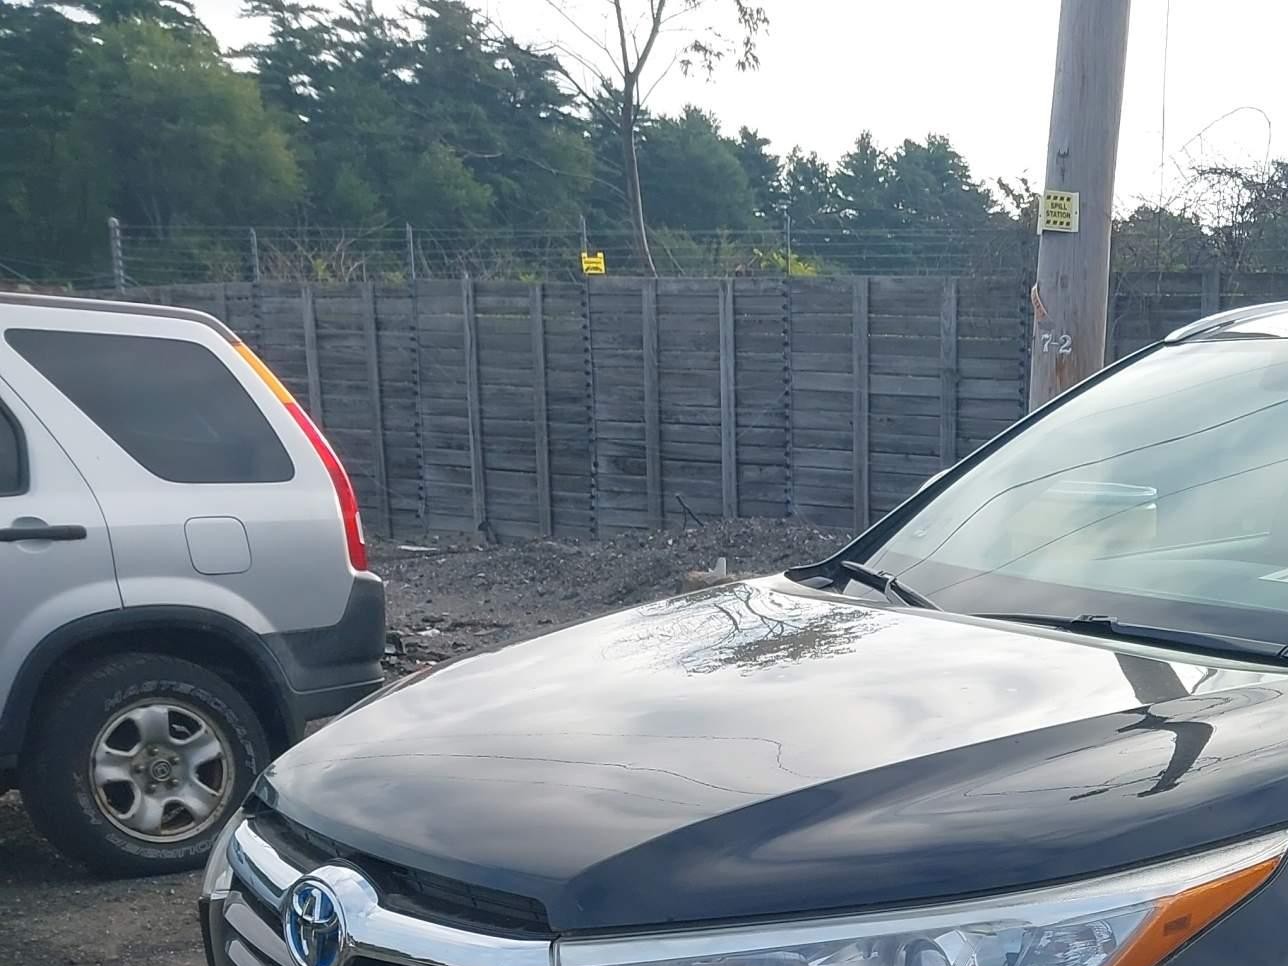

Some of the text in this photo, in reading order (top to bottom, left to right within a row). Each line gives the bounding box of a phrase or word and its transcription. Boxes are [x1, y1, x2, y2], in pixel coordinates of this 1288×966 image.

[1050, 202, 1068, 211] SPILL
[1046, 210, 1071, 219] STATION
[1041, 334, 1073, 354] 7-2
